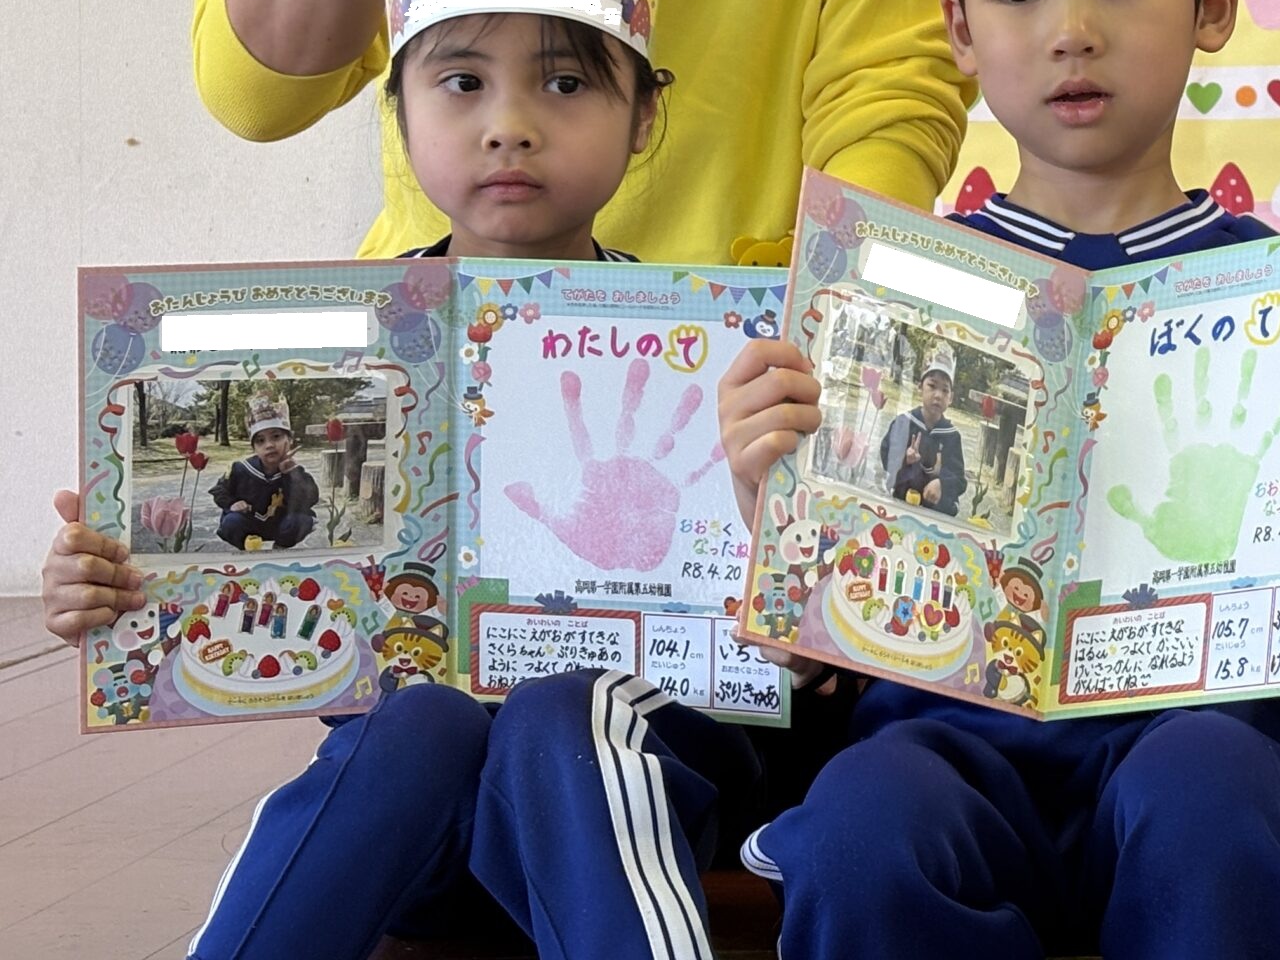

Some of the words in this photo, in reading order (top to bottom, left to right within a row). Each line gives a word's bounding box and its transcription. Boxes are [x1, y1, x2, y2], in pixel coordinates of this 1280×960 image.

[855, 221, 933, 250] おたんじょうび
[933, 239, 1040, 298] おめでとうございます
[150, 288, 248, 317] おたんじょうび
[250, 285, 393, 308] おめでとうございます
[560, 288, 608, 302] てがたを
[612, 290, 681, 305] おしましょう
[1212, 618, 1250, 639] 105.7
[649, 638, 691, 660] 104.1
[1215, 657, 1249, 680] 15.8
[659, 676, 690, 697] 14.0
